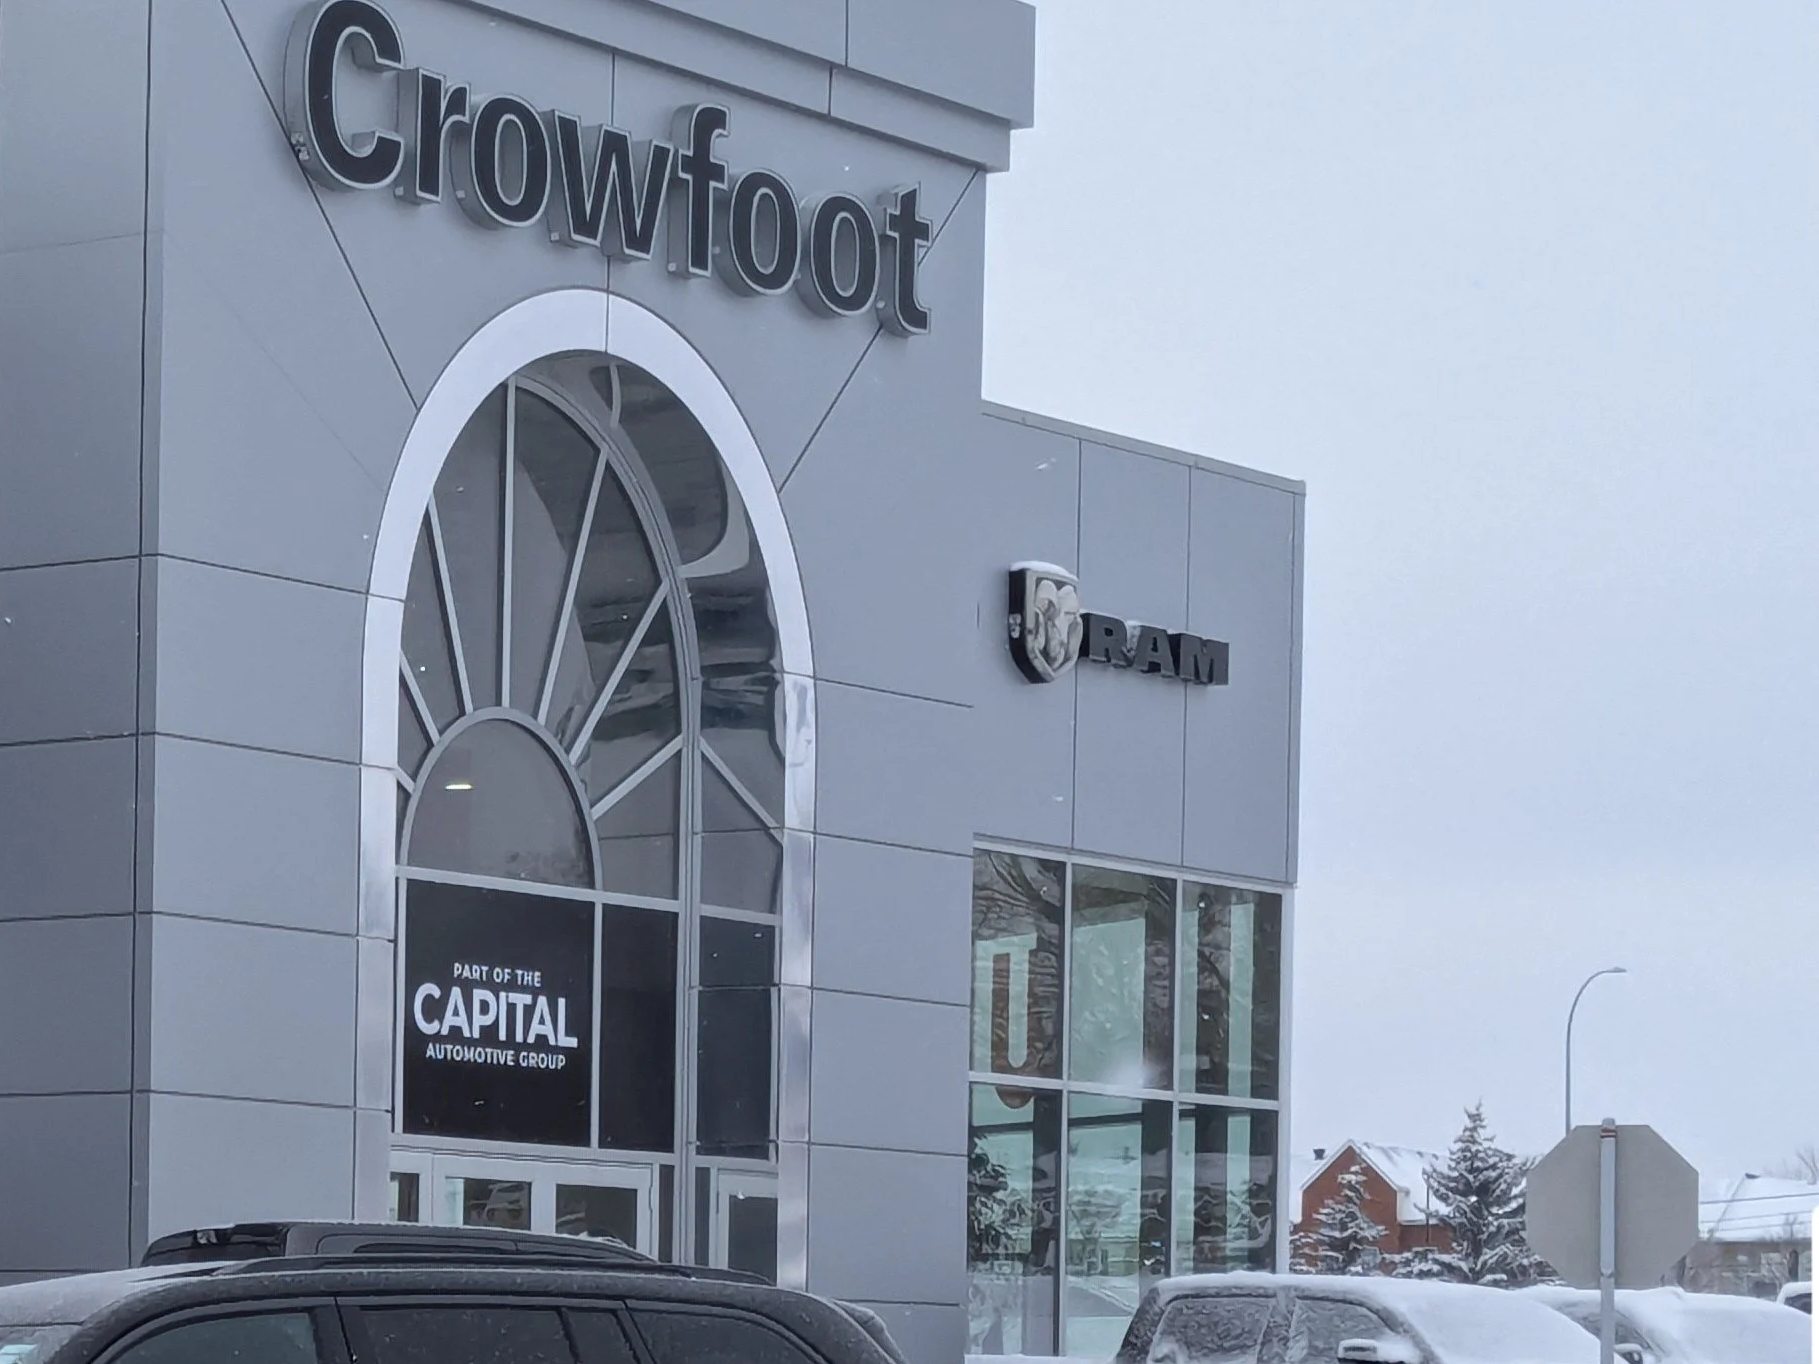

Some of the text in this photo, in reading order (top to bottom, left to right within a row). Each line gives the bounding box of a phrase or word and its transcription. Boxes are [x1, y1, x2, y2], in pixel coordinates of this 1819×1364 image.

[299, 0, 932, 337] Crowfoot
[1082, 612, 1230, 686] RAM
[453, 962, 542, 987] PART OF THE
[413, 982, 578, 1048] CAPITAL
[425, 1042, 566, 1070] AUTOMOTIVE GROUP
